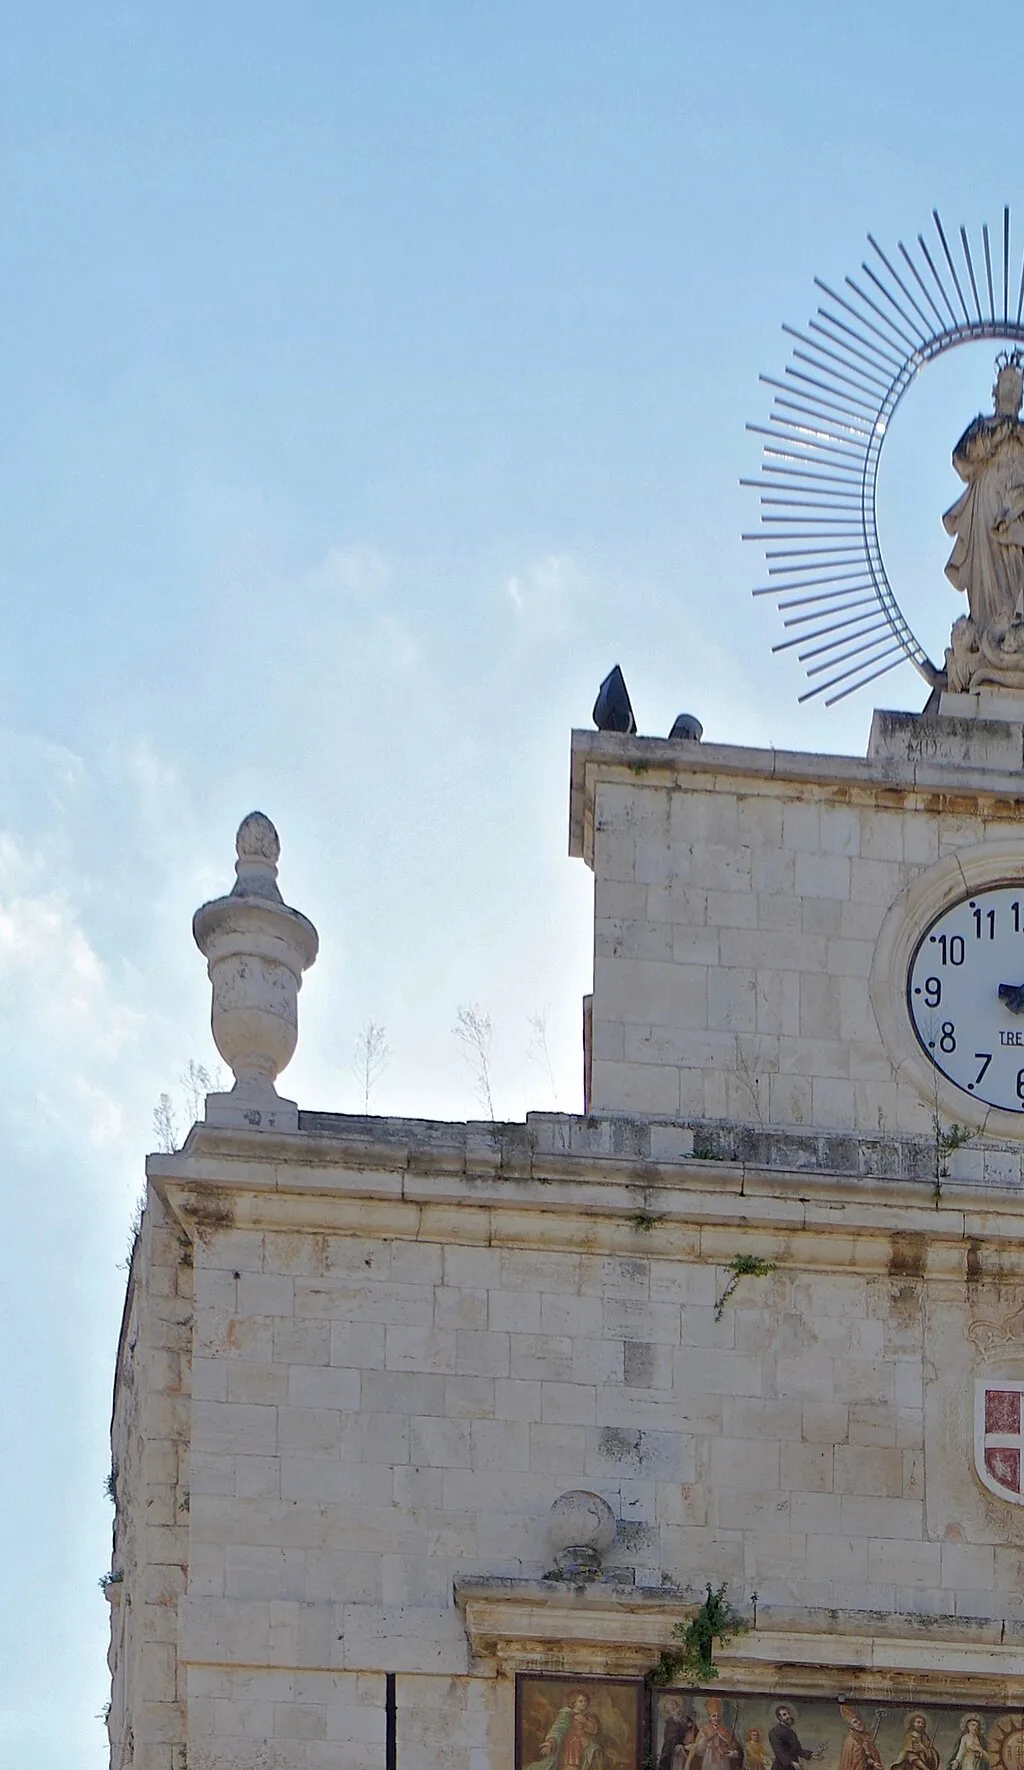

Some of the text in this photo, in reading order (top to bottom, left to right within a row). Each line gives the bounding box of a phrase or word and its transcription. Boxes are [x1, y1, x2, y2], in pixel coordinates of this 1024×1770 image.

[973, 908, 996, 940] 11
[938, 935, 965, 966] 10
[924, 976, 942, 1008] 9
[939, 1021, 957, 1054] 8
[974, 1053, 993, 1084] 7
